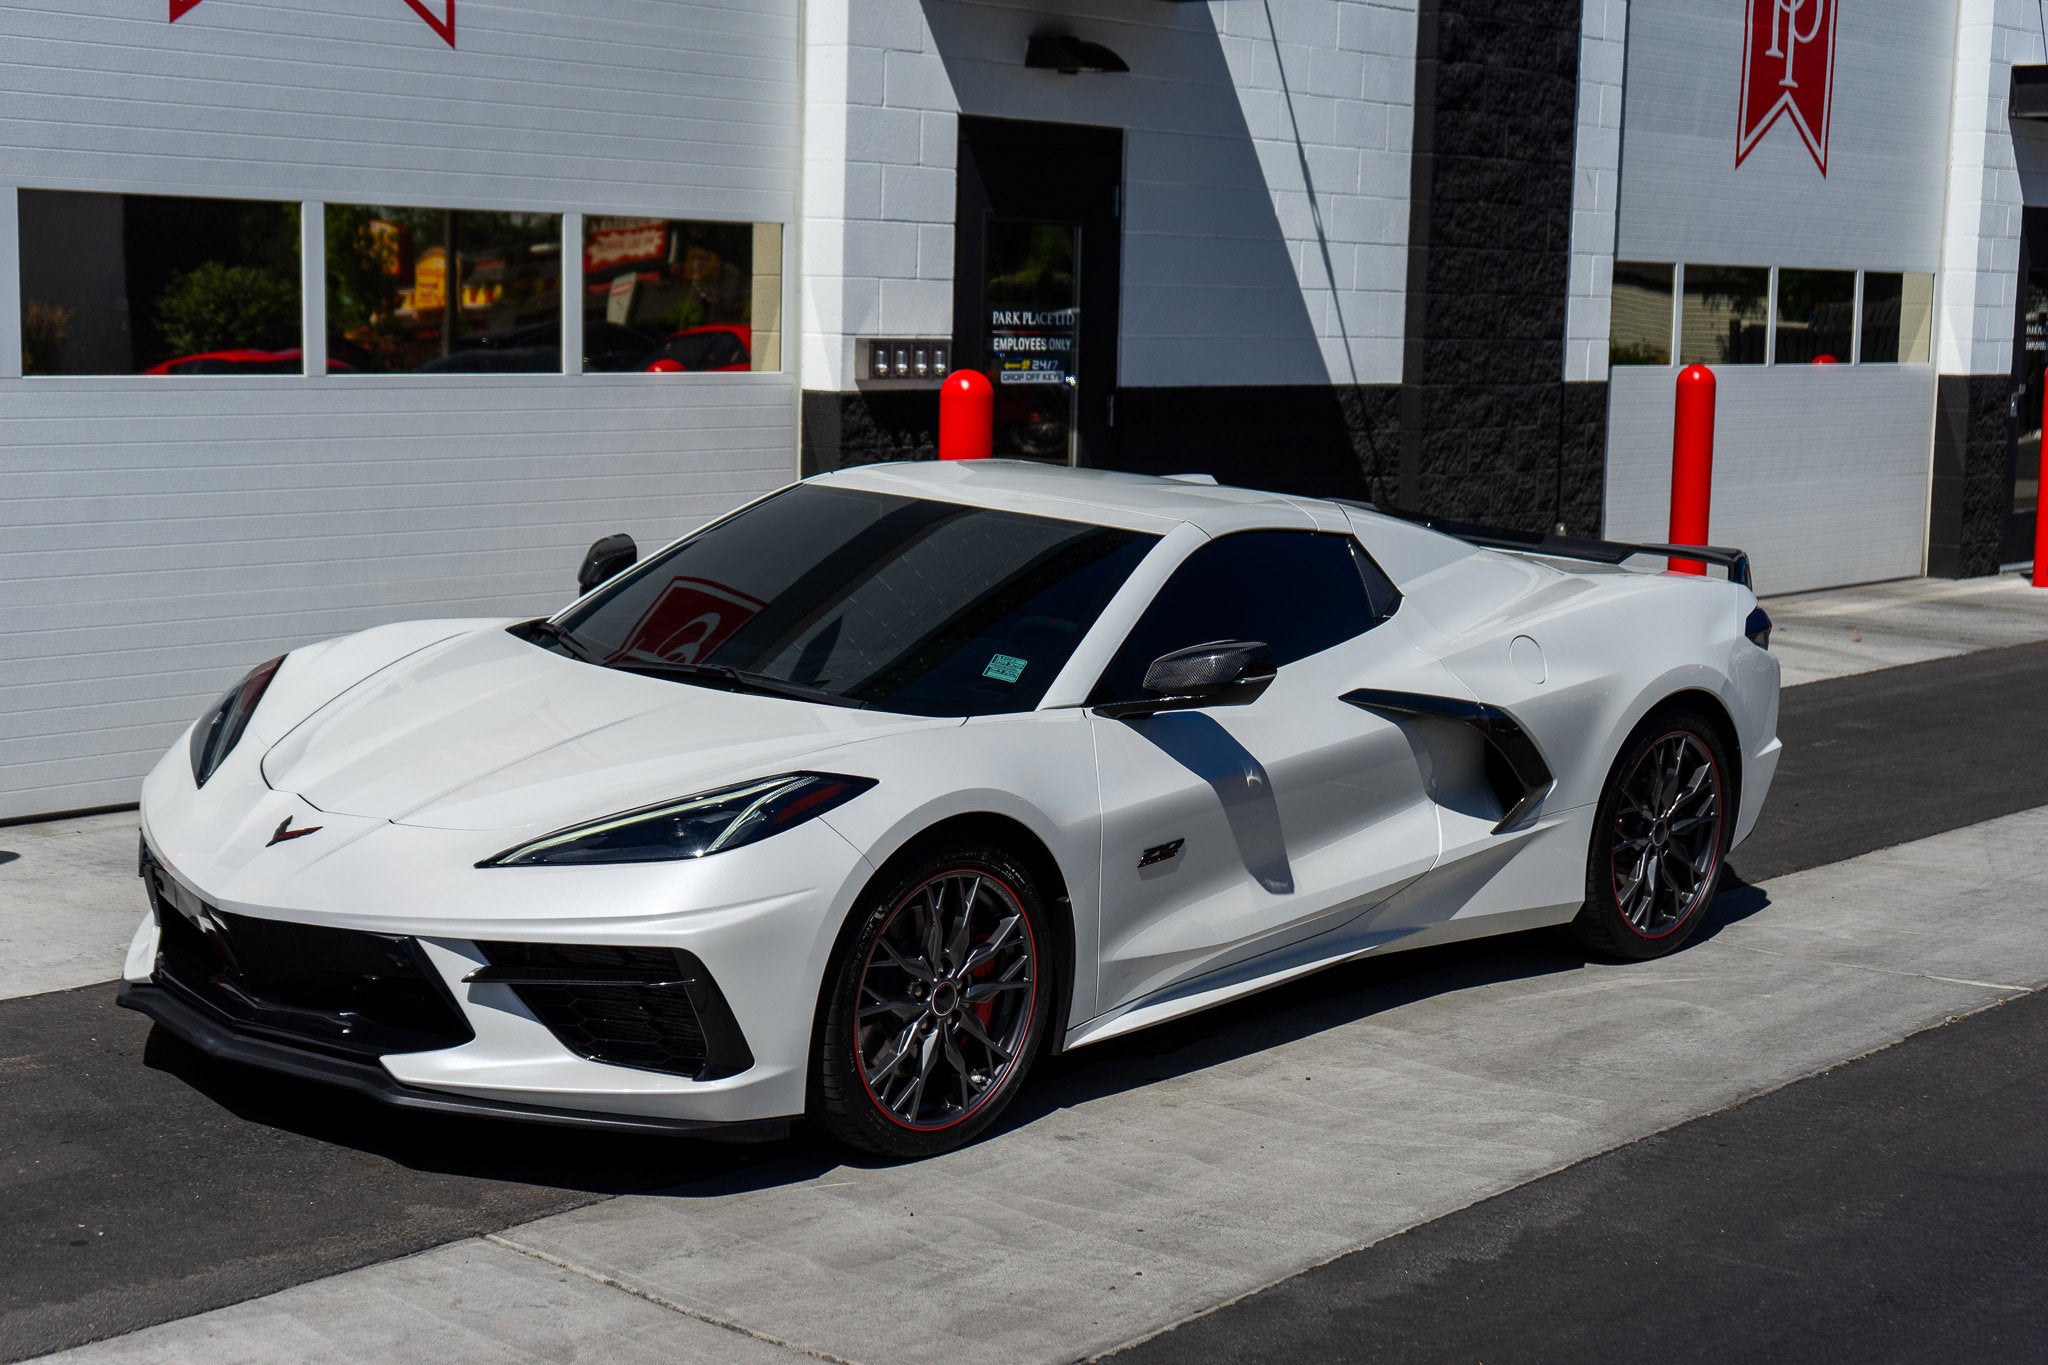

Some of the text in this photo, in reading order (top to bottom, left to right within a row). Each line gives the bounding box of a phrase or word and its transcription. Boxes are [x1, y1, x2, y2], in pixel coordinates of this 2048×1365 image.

[993, 310, 1021, 325] PARK
[1023, 310, 1053, 325] PLACE
[993, 336, 1072, 351] EMPLOYEES ONLY
[1032, 359, 1059, 370] 24/7
[1003, 373, 1062, 381] DROP OFF KEYS
